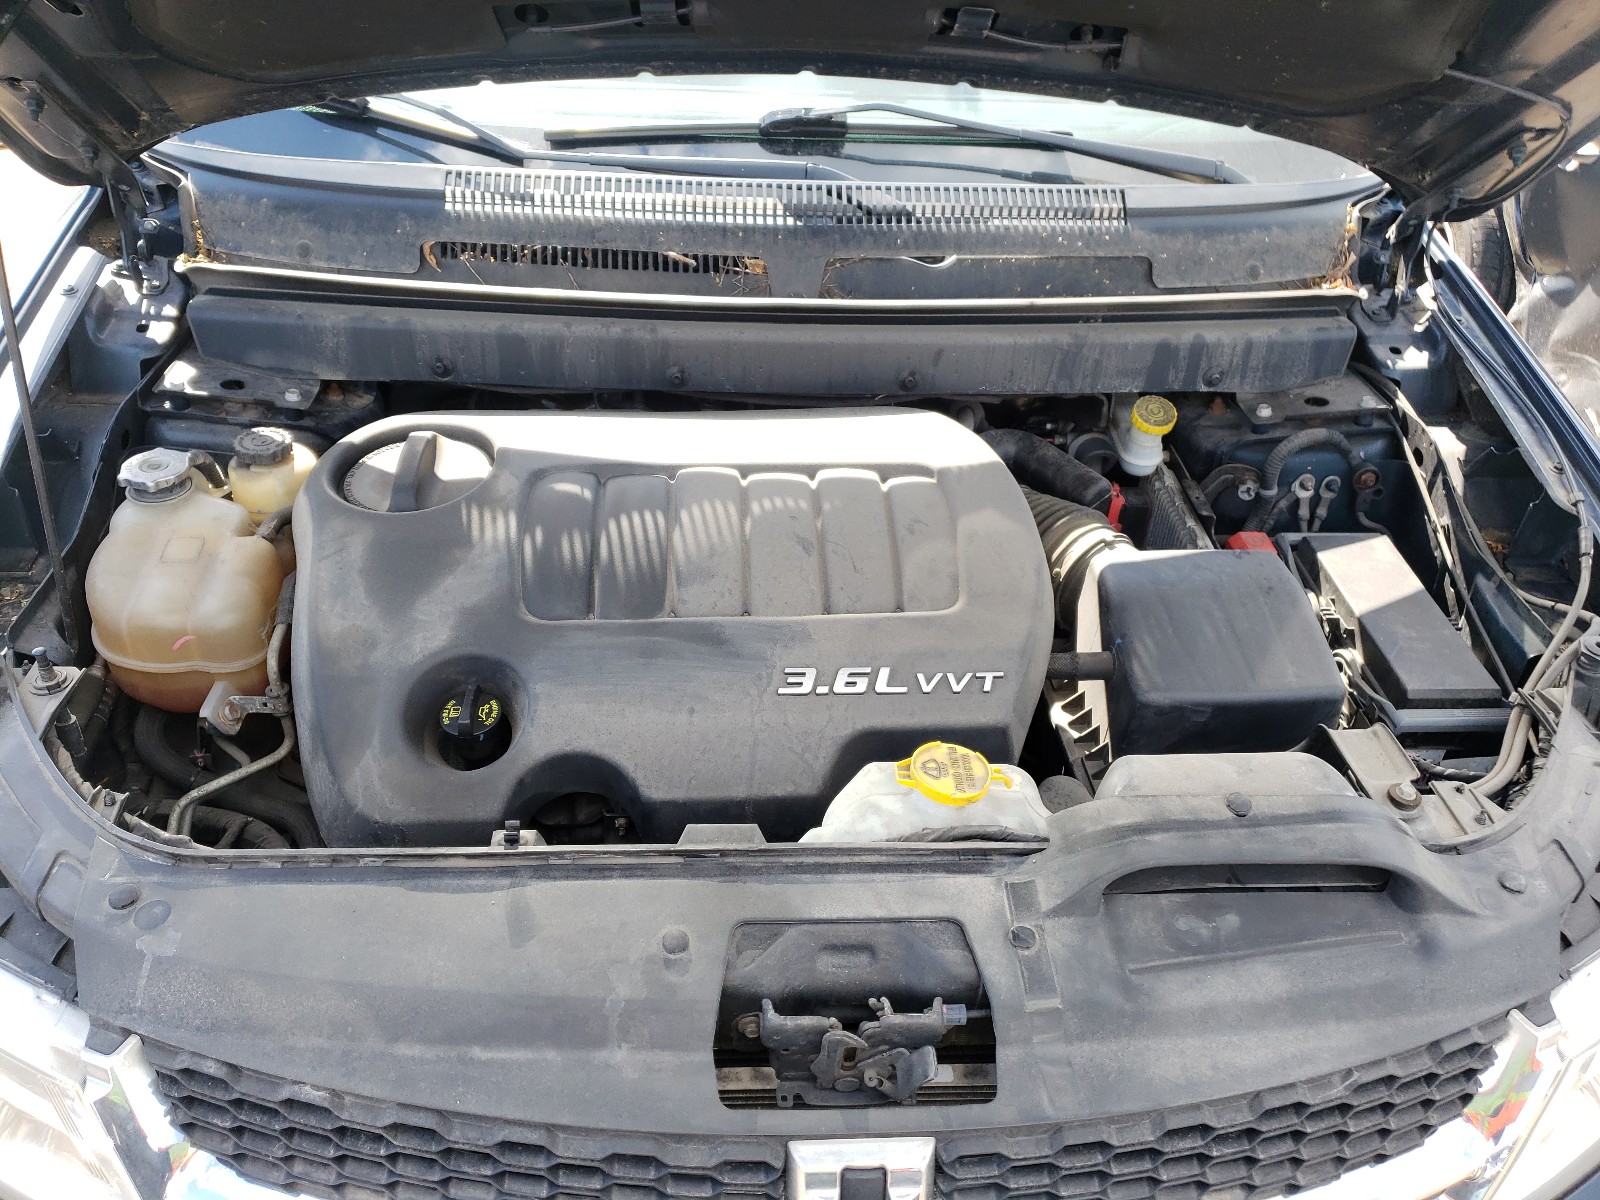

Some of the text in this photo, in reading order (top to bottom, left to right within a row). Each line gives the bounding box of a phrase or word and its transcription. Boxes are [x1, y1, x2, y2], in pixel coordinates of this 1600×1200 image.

[777, 666, 1005, 696] 3.6L VVT
[946, 746, 967, 794] FLUID ONLY
